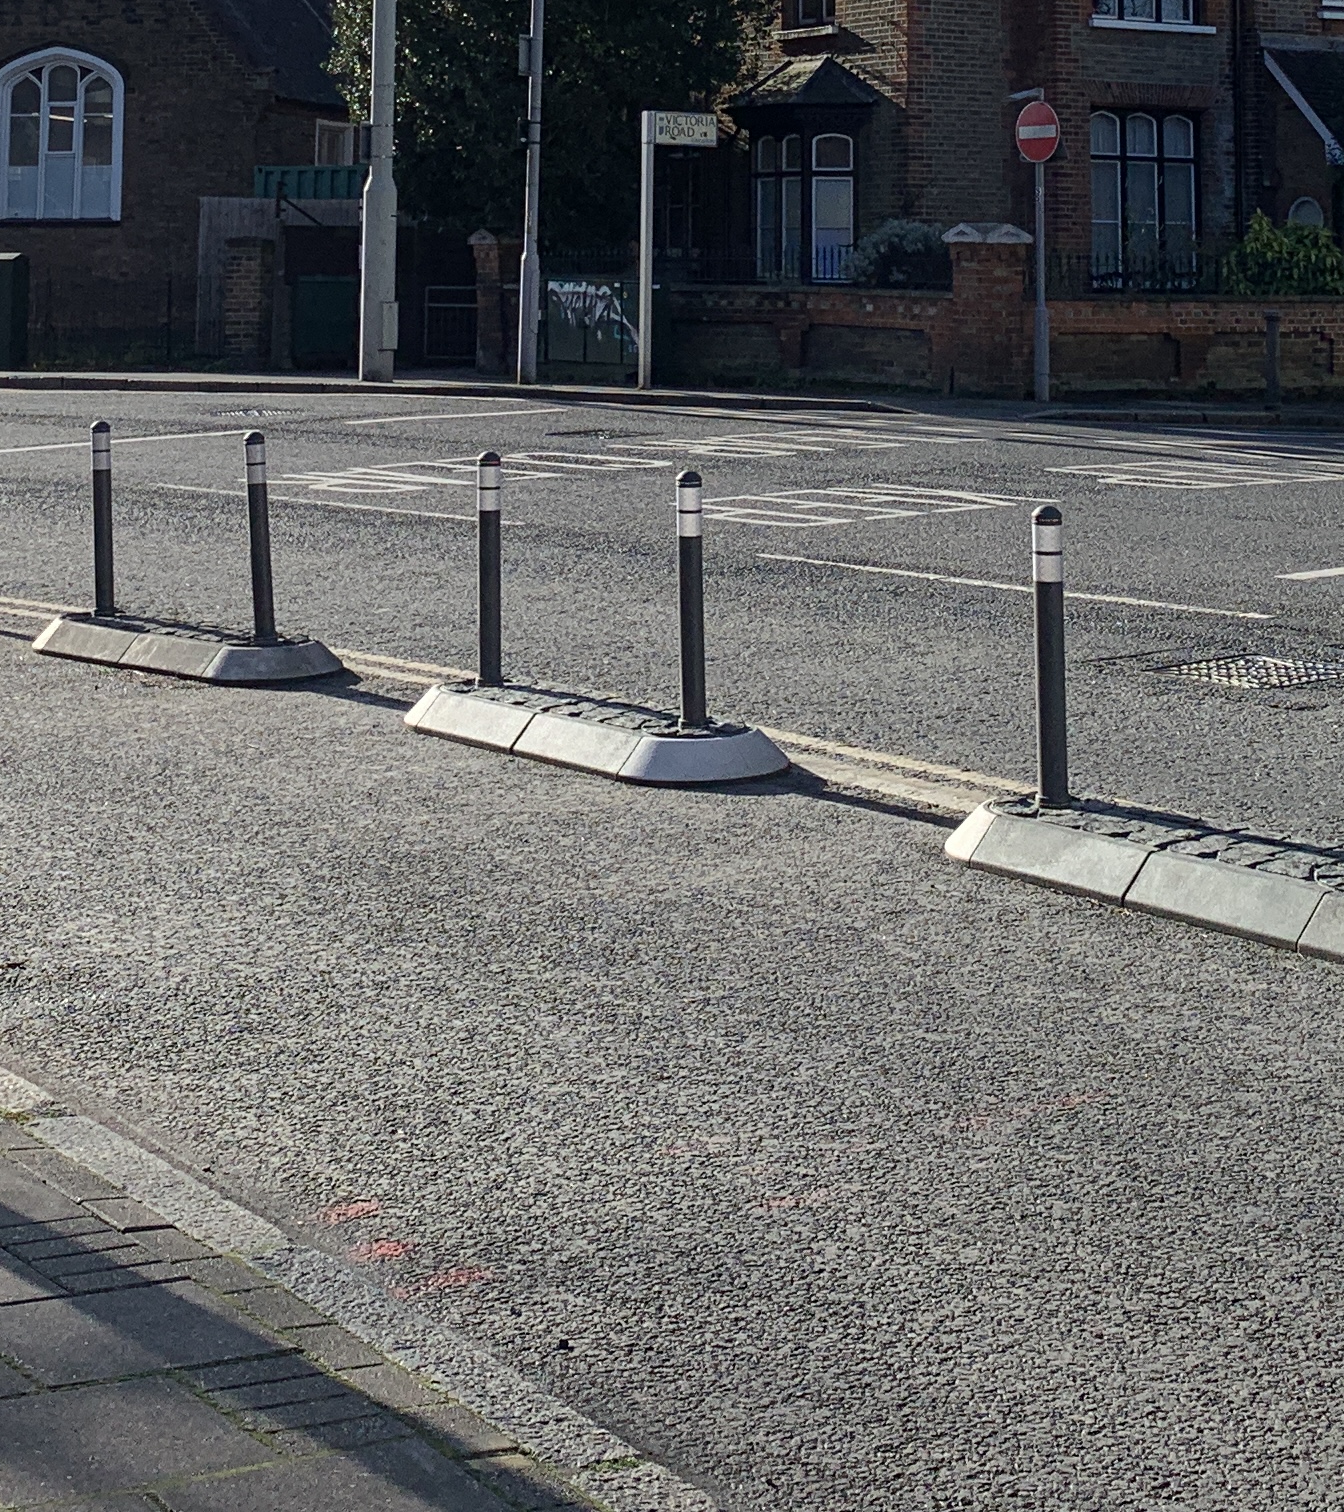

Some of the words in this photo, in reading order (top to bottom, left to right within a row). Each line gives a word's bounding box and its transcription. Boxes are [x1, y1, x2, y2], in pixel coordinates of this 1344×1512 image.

[665, 125, 695, 138] ROAD
[666, 115, 716, 128] VICTORIA
[241, 451, 674, 493] CLEAR
[671, 483, 1064, 527] KEEP
